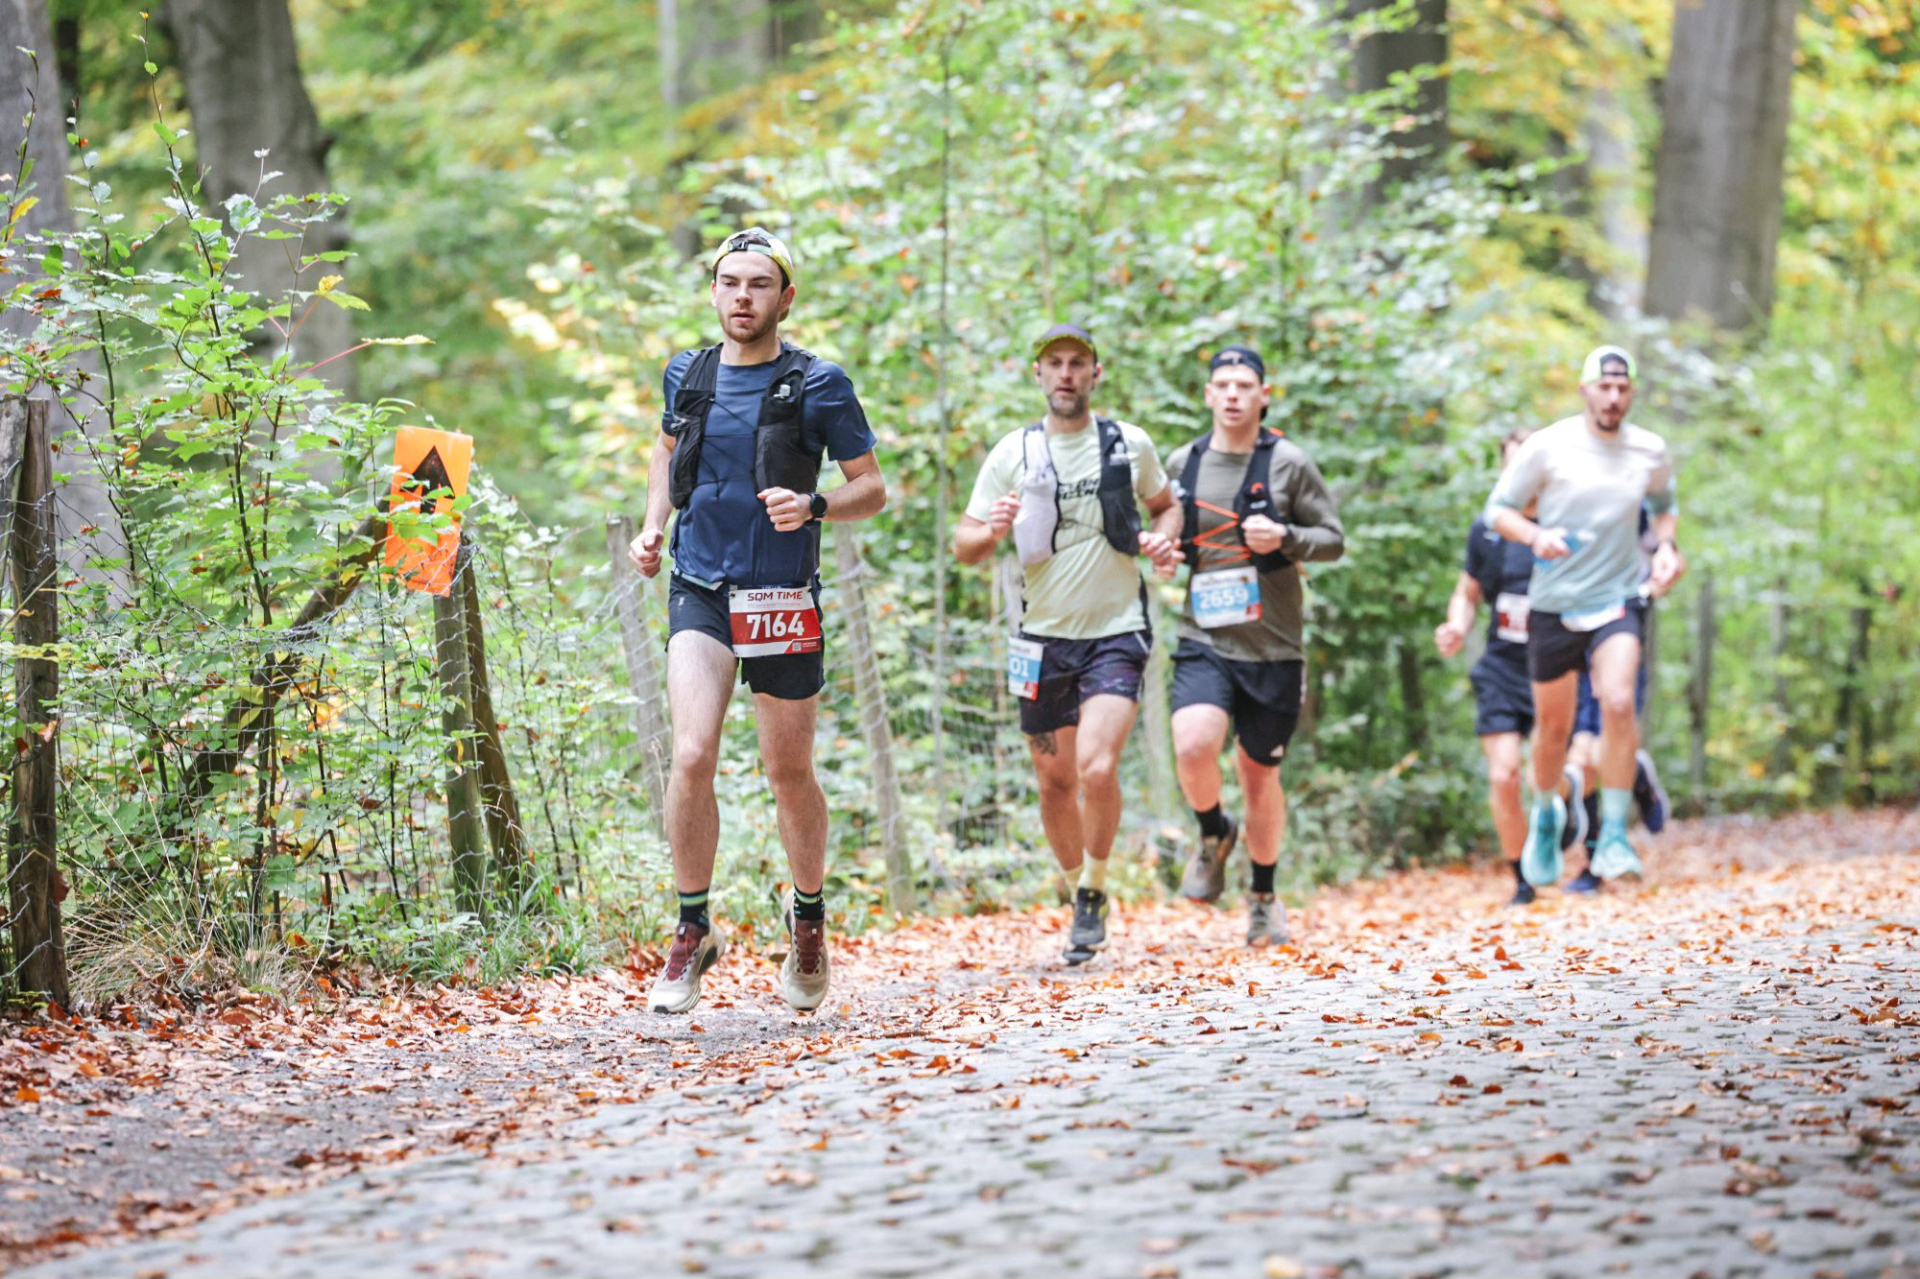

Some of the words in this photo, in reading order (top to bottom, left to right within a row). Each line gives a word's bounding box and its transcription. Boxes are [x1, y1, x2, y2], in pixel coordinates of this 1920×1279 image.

[747, 592, 773, 601] SQM
[1200, 586, 1249, 609] 2659
[746, 612, 805, 639] 7164
